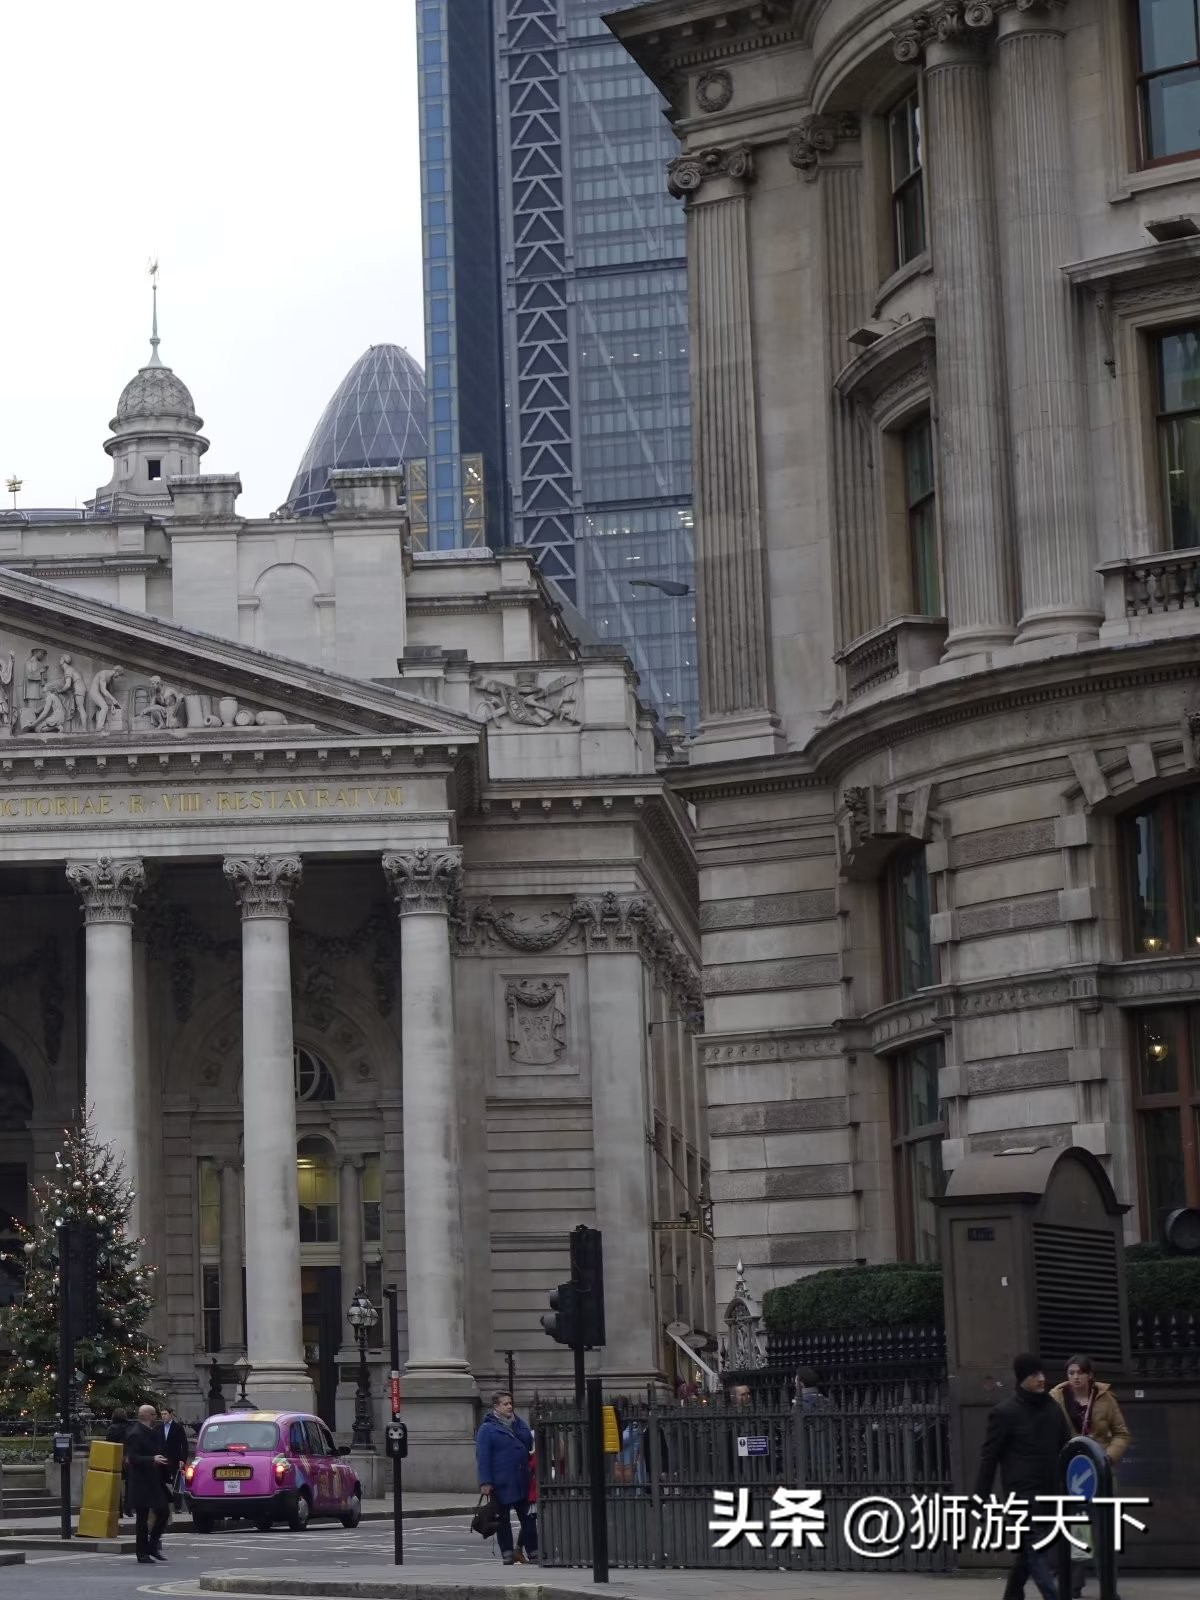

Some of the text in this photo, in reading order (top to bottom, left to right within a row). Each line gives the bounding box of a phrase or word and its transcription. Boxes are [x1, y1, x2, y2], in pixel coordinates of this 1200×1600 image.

[128, 792, 147, 814] R
[161, 791, 203, 813] VIII
[216, 785, 404, 812] RESTAVRATVM
